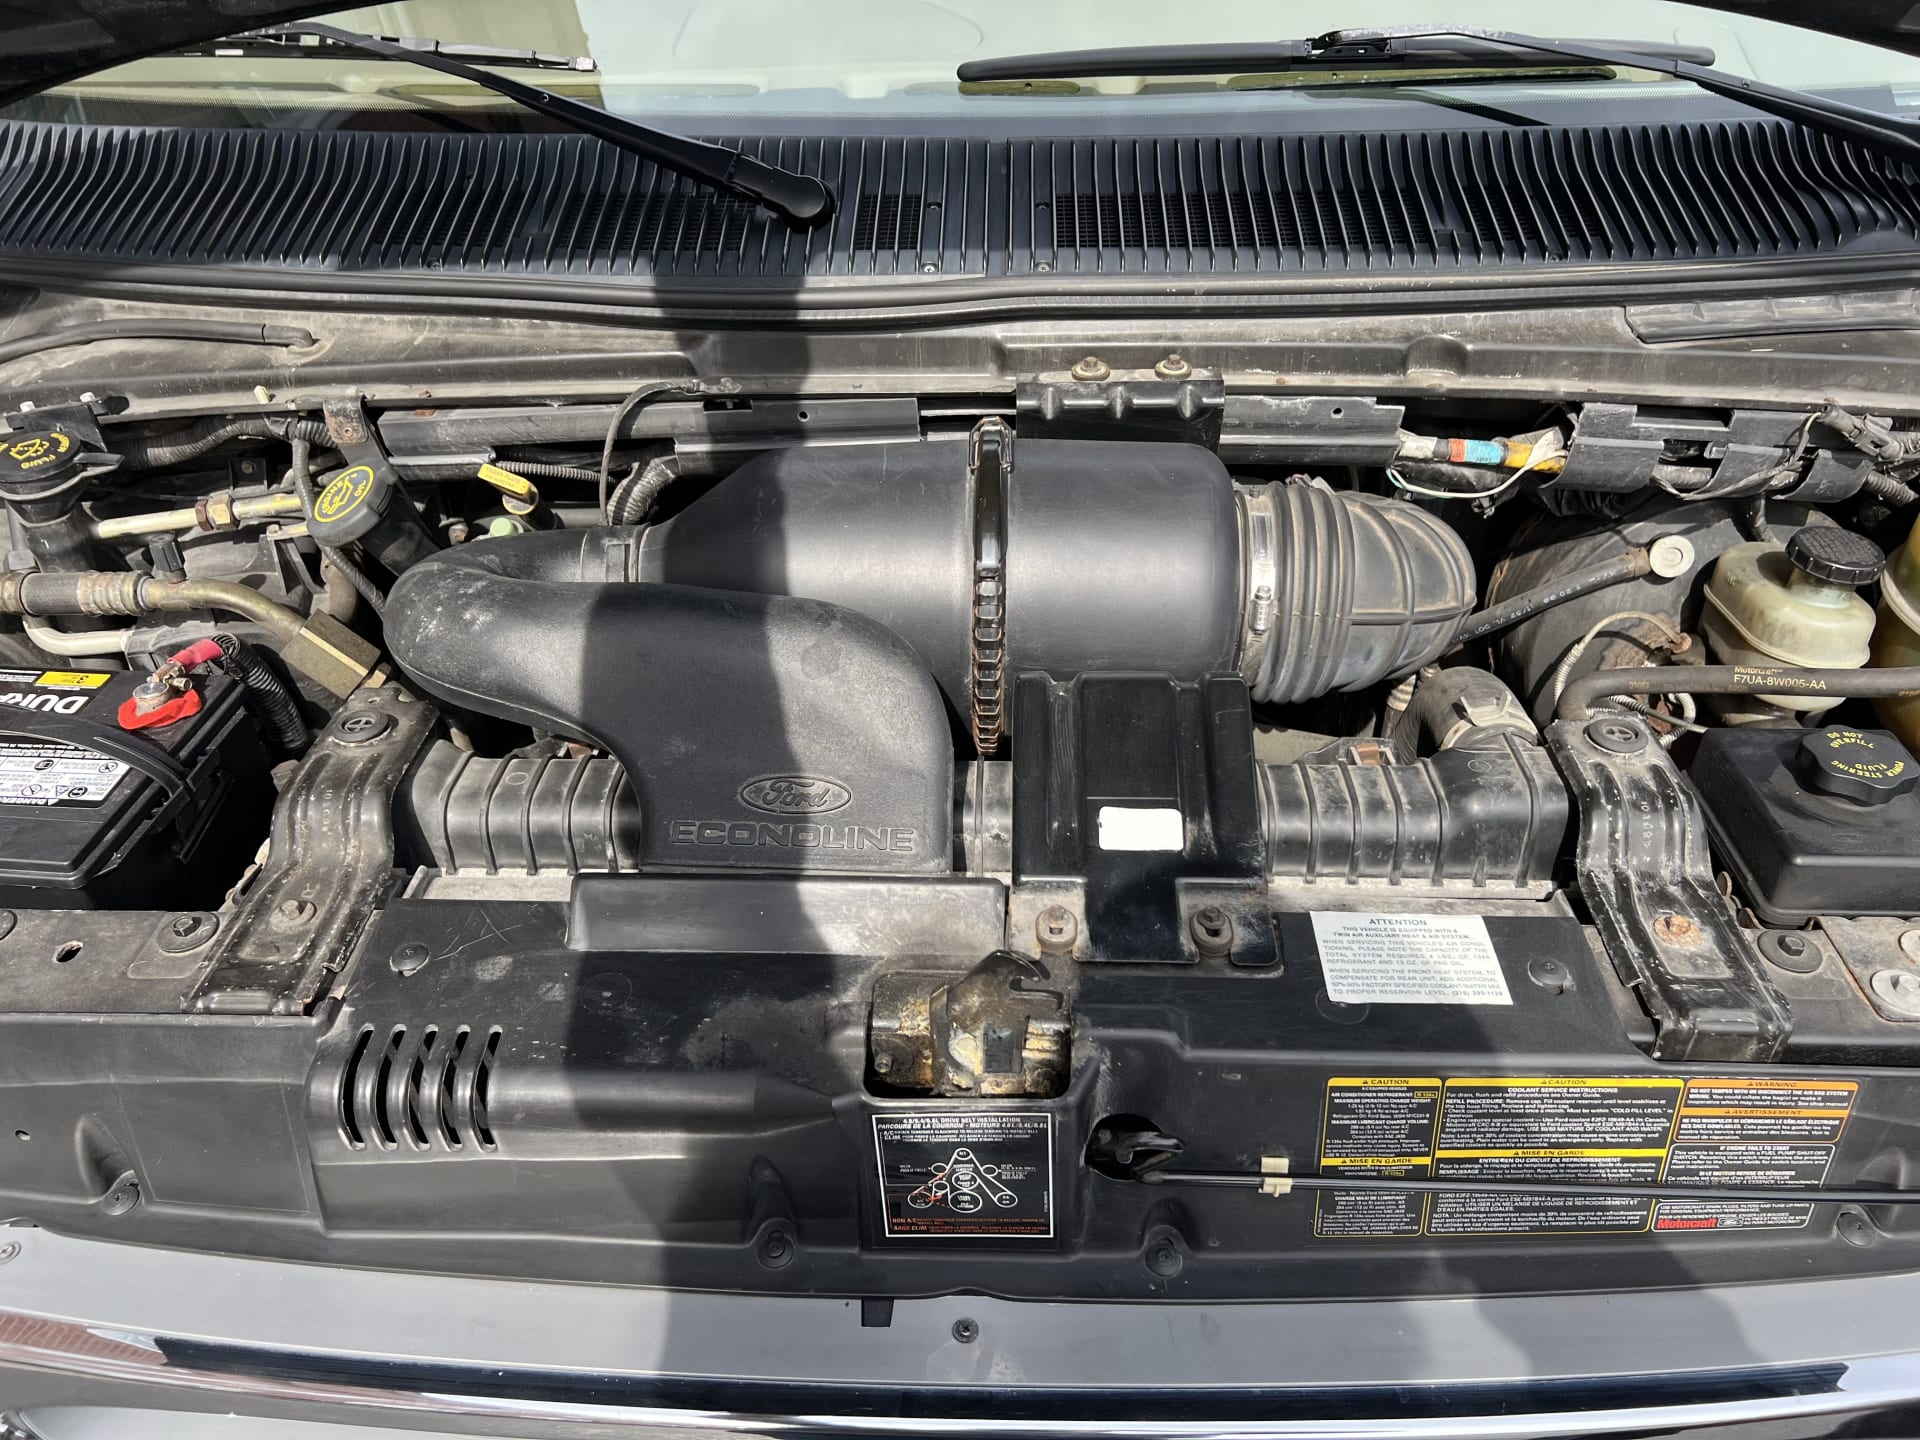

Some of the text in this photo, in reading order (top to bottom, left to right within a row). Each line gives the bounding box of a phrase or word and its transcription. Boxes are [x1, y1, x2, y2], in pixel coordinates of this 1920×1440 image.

[354, 480, 366, 496] OIL
[76, 675, 89, 684] 3
[1734, 674, 1826, 690] F7UA-8W005-AA
[1830, 738, 1874, 748] OVERFILL
[1830, 760, 1883, 778] STEERING
[1854, 762, 1888, 770] FLUID
[761, 780, 831, 808] Ford
[671, 820, 915, 852] ECONOLINE
[1656, 1218, 1717, 1229] Motorcraft
